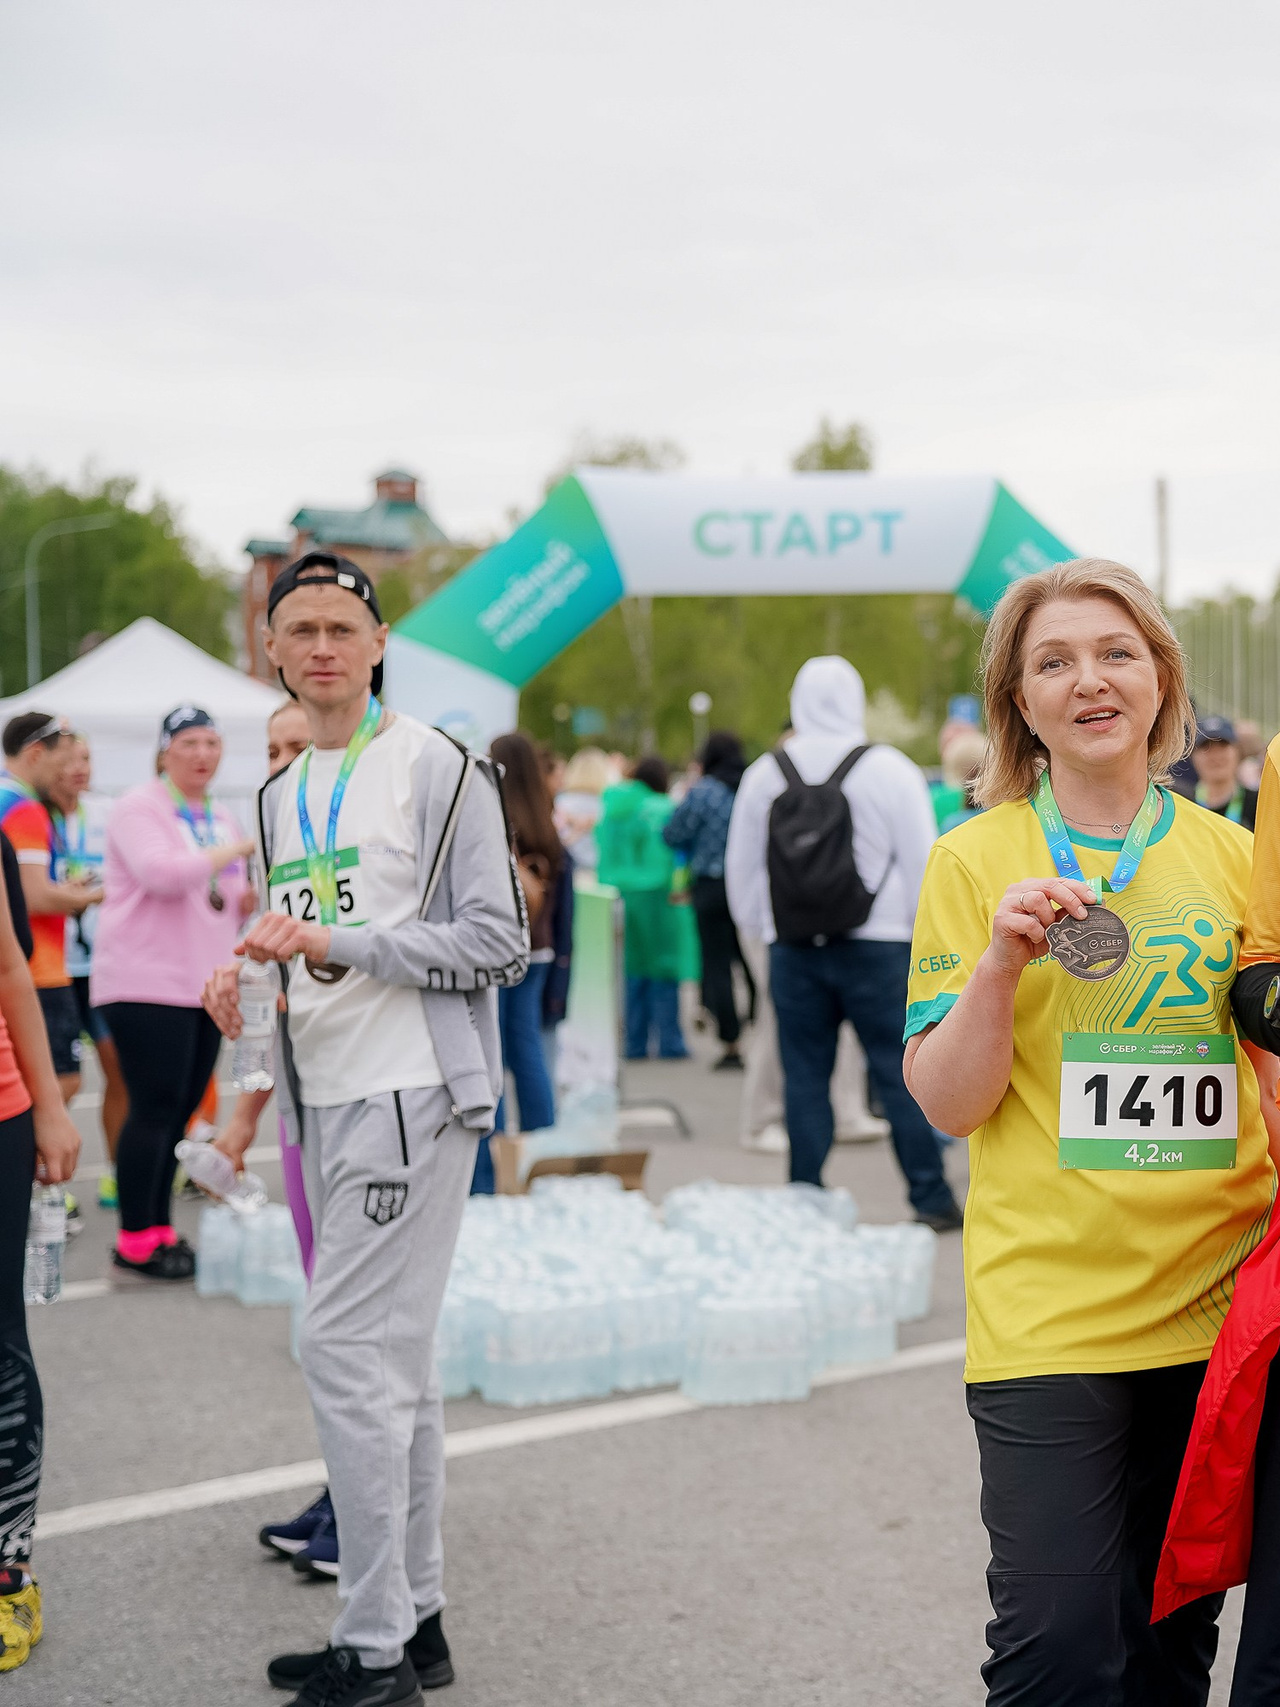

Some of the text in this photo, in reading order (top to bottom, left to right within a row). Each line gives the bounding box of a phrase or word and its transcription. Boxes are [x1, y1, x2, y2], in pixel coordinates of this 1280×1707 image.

[692, 510, 903, 556] СТАРТ
[281, 878, 354, 921] 125
[1101, 939, 1123, 948] СБЕР
[918, 953, 961, 974] СБЕР
[1112, 1045, 1138, 1053] СБЕР
[1084, 1074, 1222, 1127] 1410
